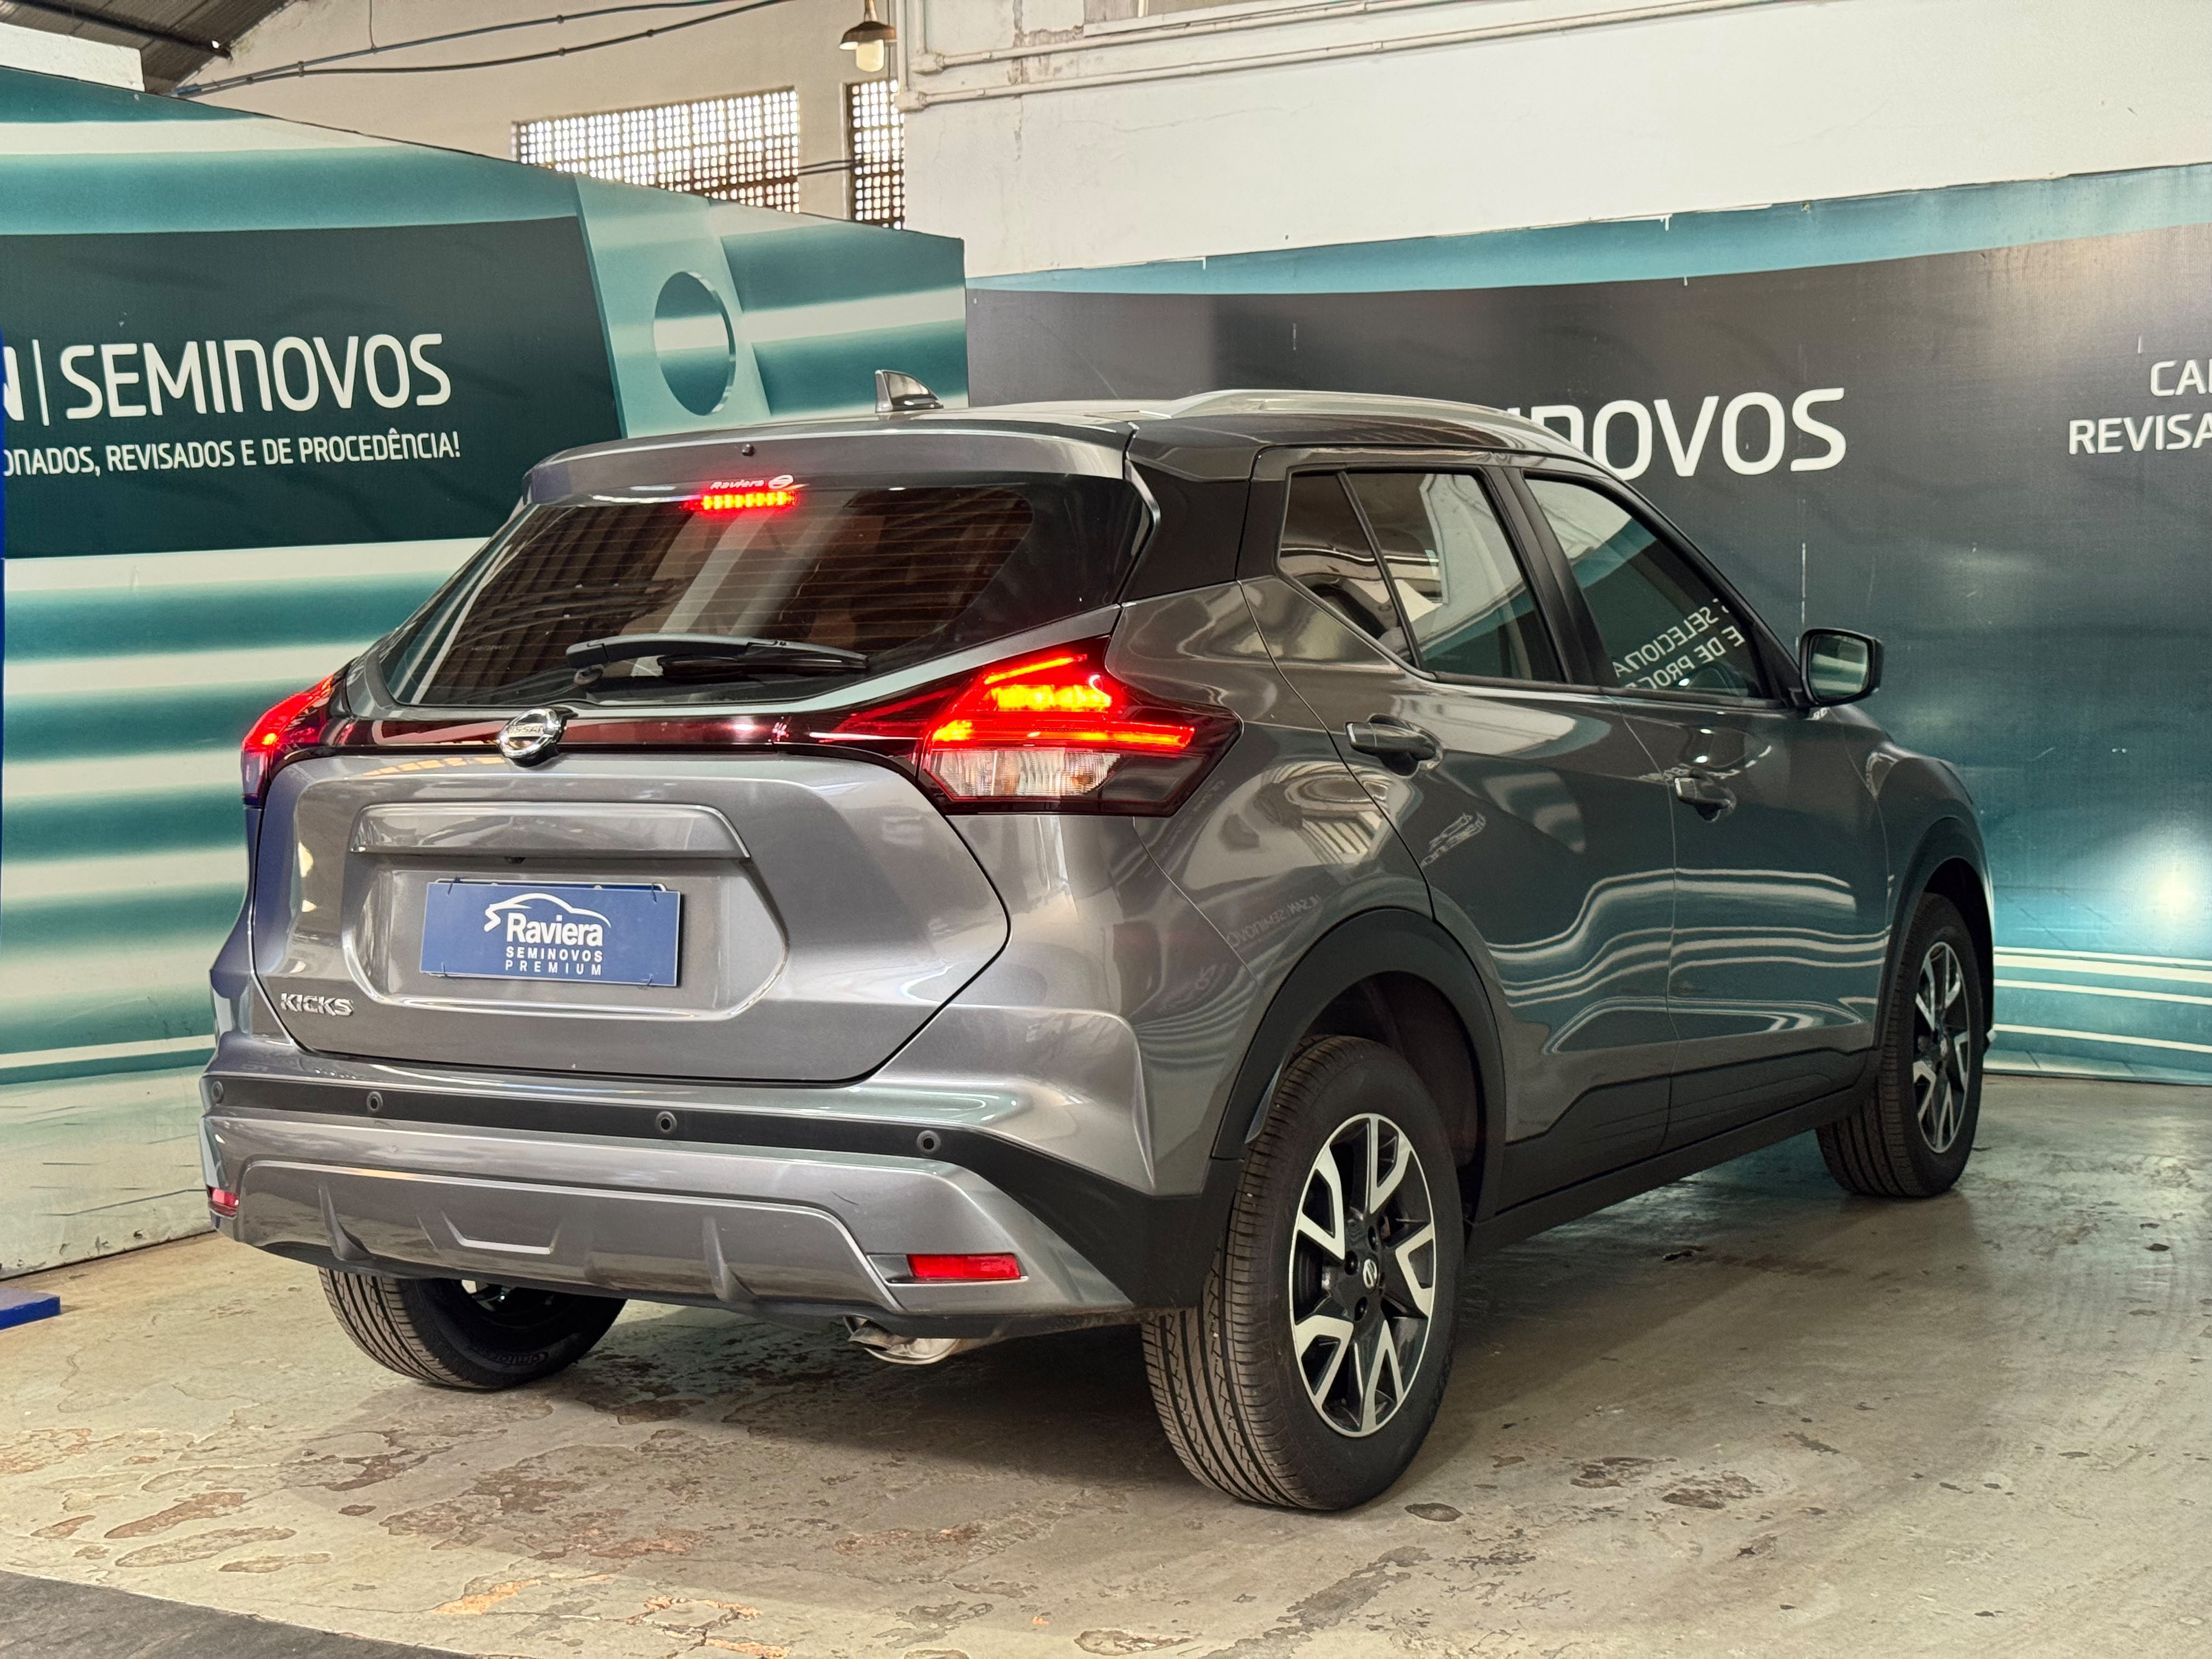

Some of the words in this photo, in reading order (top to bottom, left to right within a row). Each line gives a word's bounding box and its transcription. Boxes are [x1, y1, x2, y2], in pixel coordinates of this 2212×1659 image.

[60, 333, 451, 419] SEMINOVOS
[2150, 359, 2212, 396] CA
[106, 441, 235, 471] REVISADOS
[241, 439, 257, 466] E
[262, 438, 294, 465] DE
[299, 427, 461, 464] PROCEDÊNCIA!
[506, 912, 603, 947] Raviera
[505, 960, 602, 975] PREMIUM
[506, 946, 603, 962] SEMINOVOS
[280, 992, 354, 1017] KICKS
